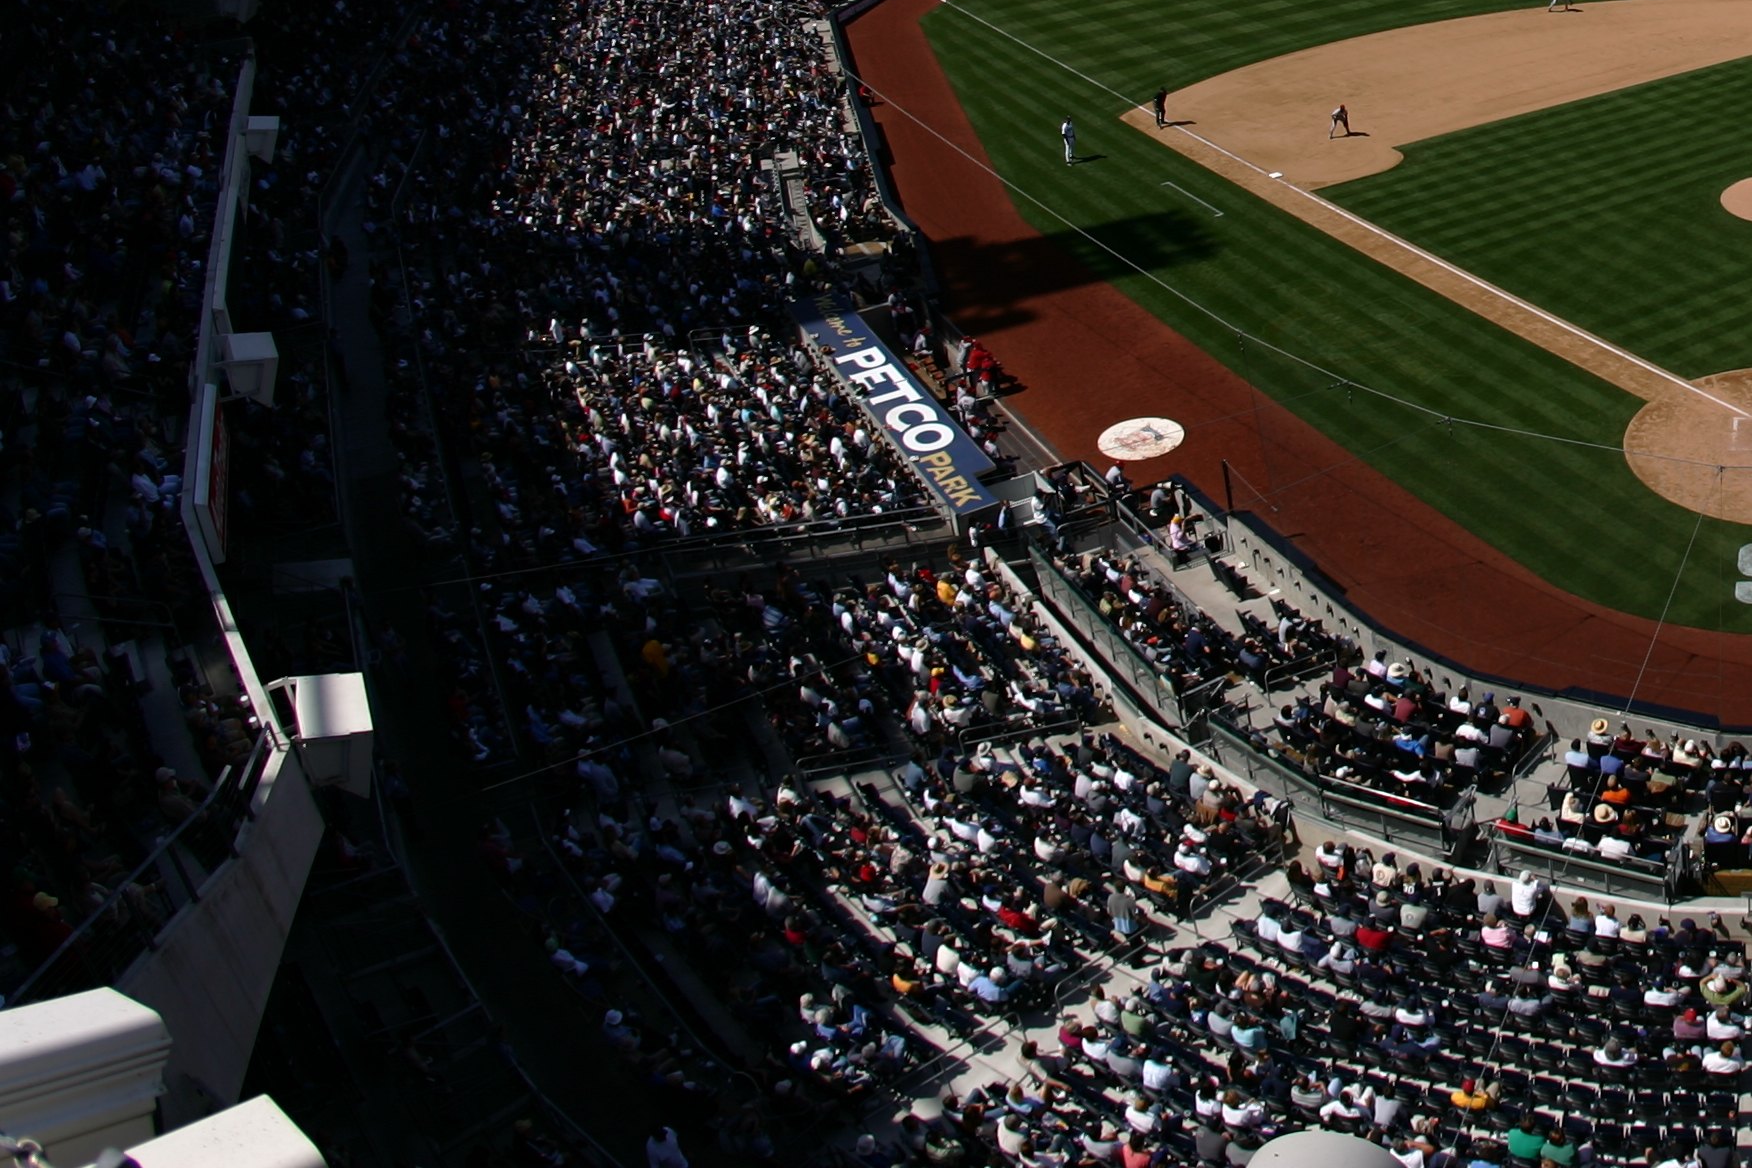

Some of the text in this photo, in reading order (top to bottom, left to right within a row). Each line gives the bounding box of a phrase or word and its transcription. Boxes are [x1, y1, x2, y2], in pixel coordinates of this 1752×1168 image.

[814, 294, 866, 349] Welcome to
[834, 345, 982, 509] PETCO PARK
